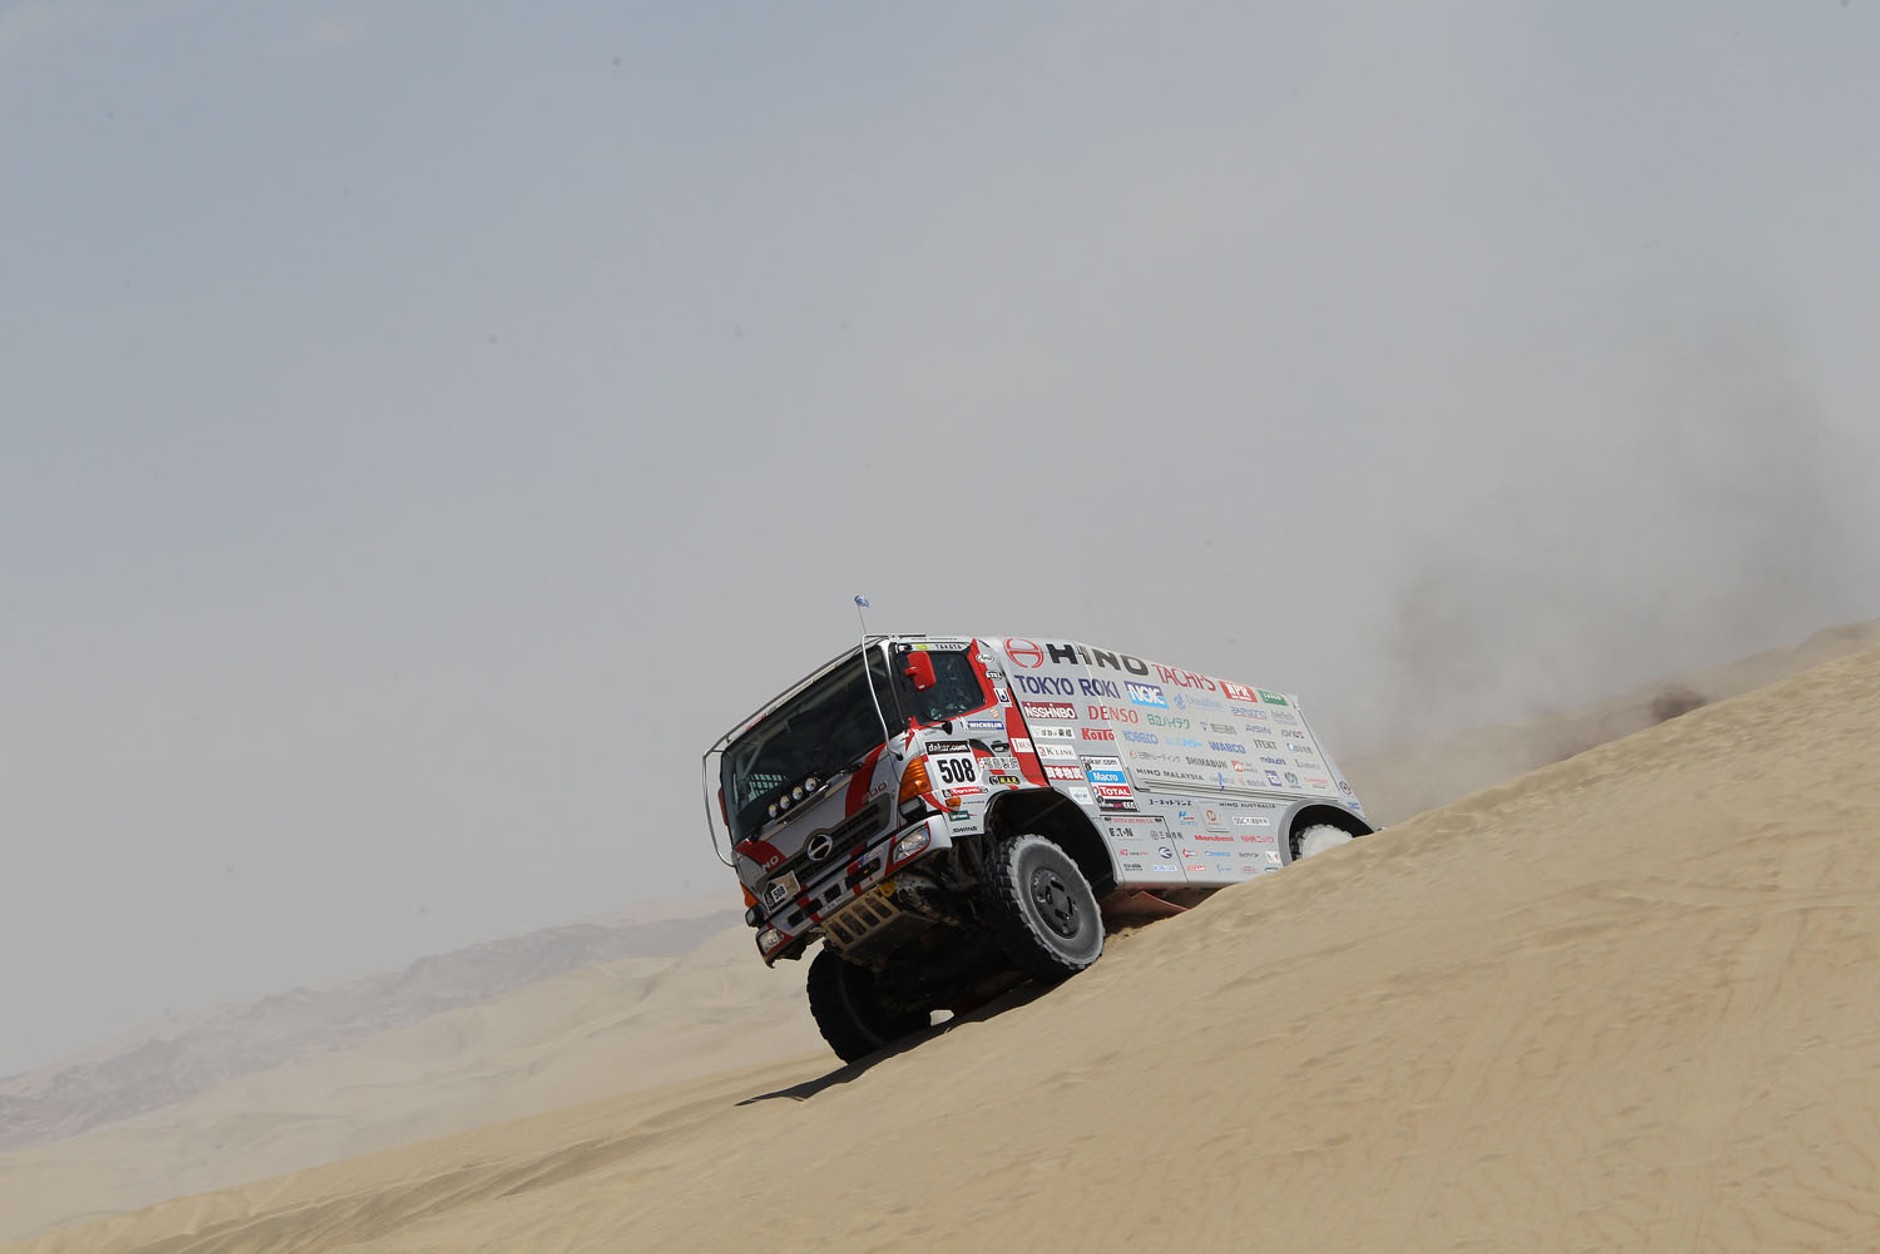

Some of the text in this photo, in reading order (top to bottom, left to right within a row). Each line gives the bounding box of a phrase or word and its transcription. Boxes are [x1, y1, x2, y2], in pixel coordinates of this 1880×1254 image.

[1045, 643, 1149, 676] HINO
[1014, 675, 1121, 699] TOKYO ROKI
[1126, 684, 1165, 704] NOK
[1088, 705, 1138, 724] DENSO
[928, 743, 967, 752] dakar.com
[1209, 741, 1246, 753] WABCO
[937, 758, 976, 783] 508
[1093, 772, 1118, 781] Macro
[1162, 771, 1204, 780] MALAYSIA
[1102, 787, 1131, 797] TOTAL
[773, 886, 786, 899] 508
